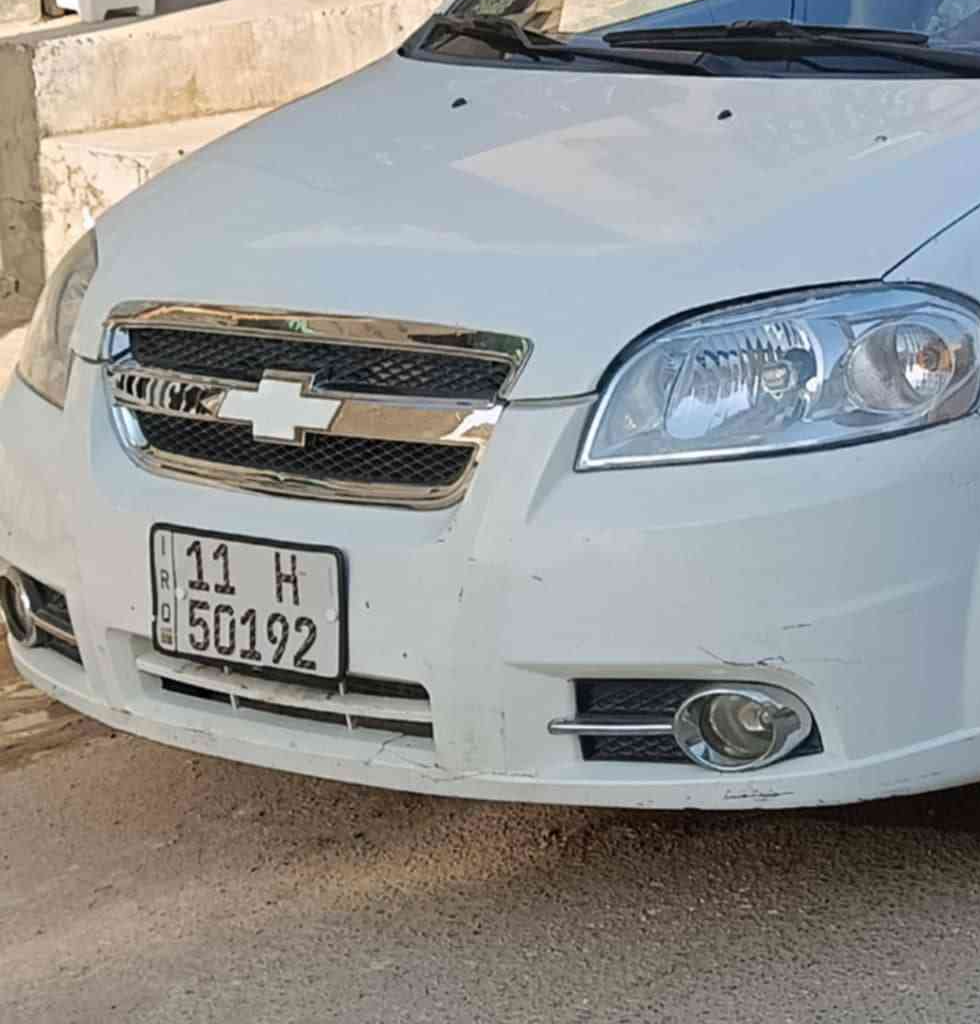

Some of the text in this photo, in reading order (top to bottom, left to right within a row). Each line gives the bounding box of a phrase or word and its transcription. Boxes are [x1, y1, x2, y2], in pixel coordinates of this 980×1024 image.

[186, 540, 300, 606] 11 H
[189, 599, 318, 671] 50192
